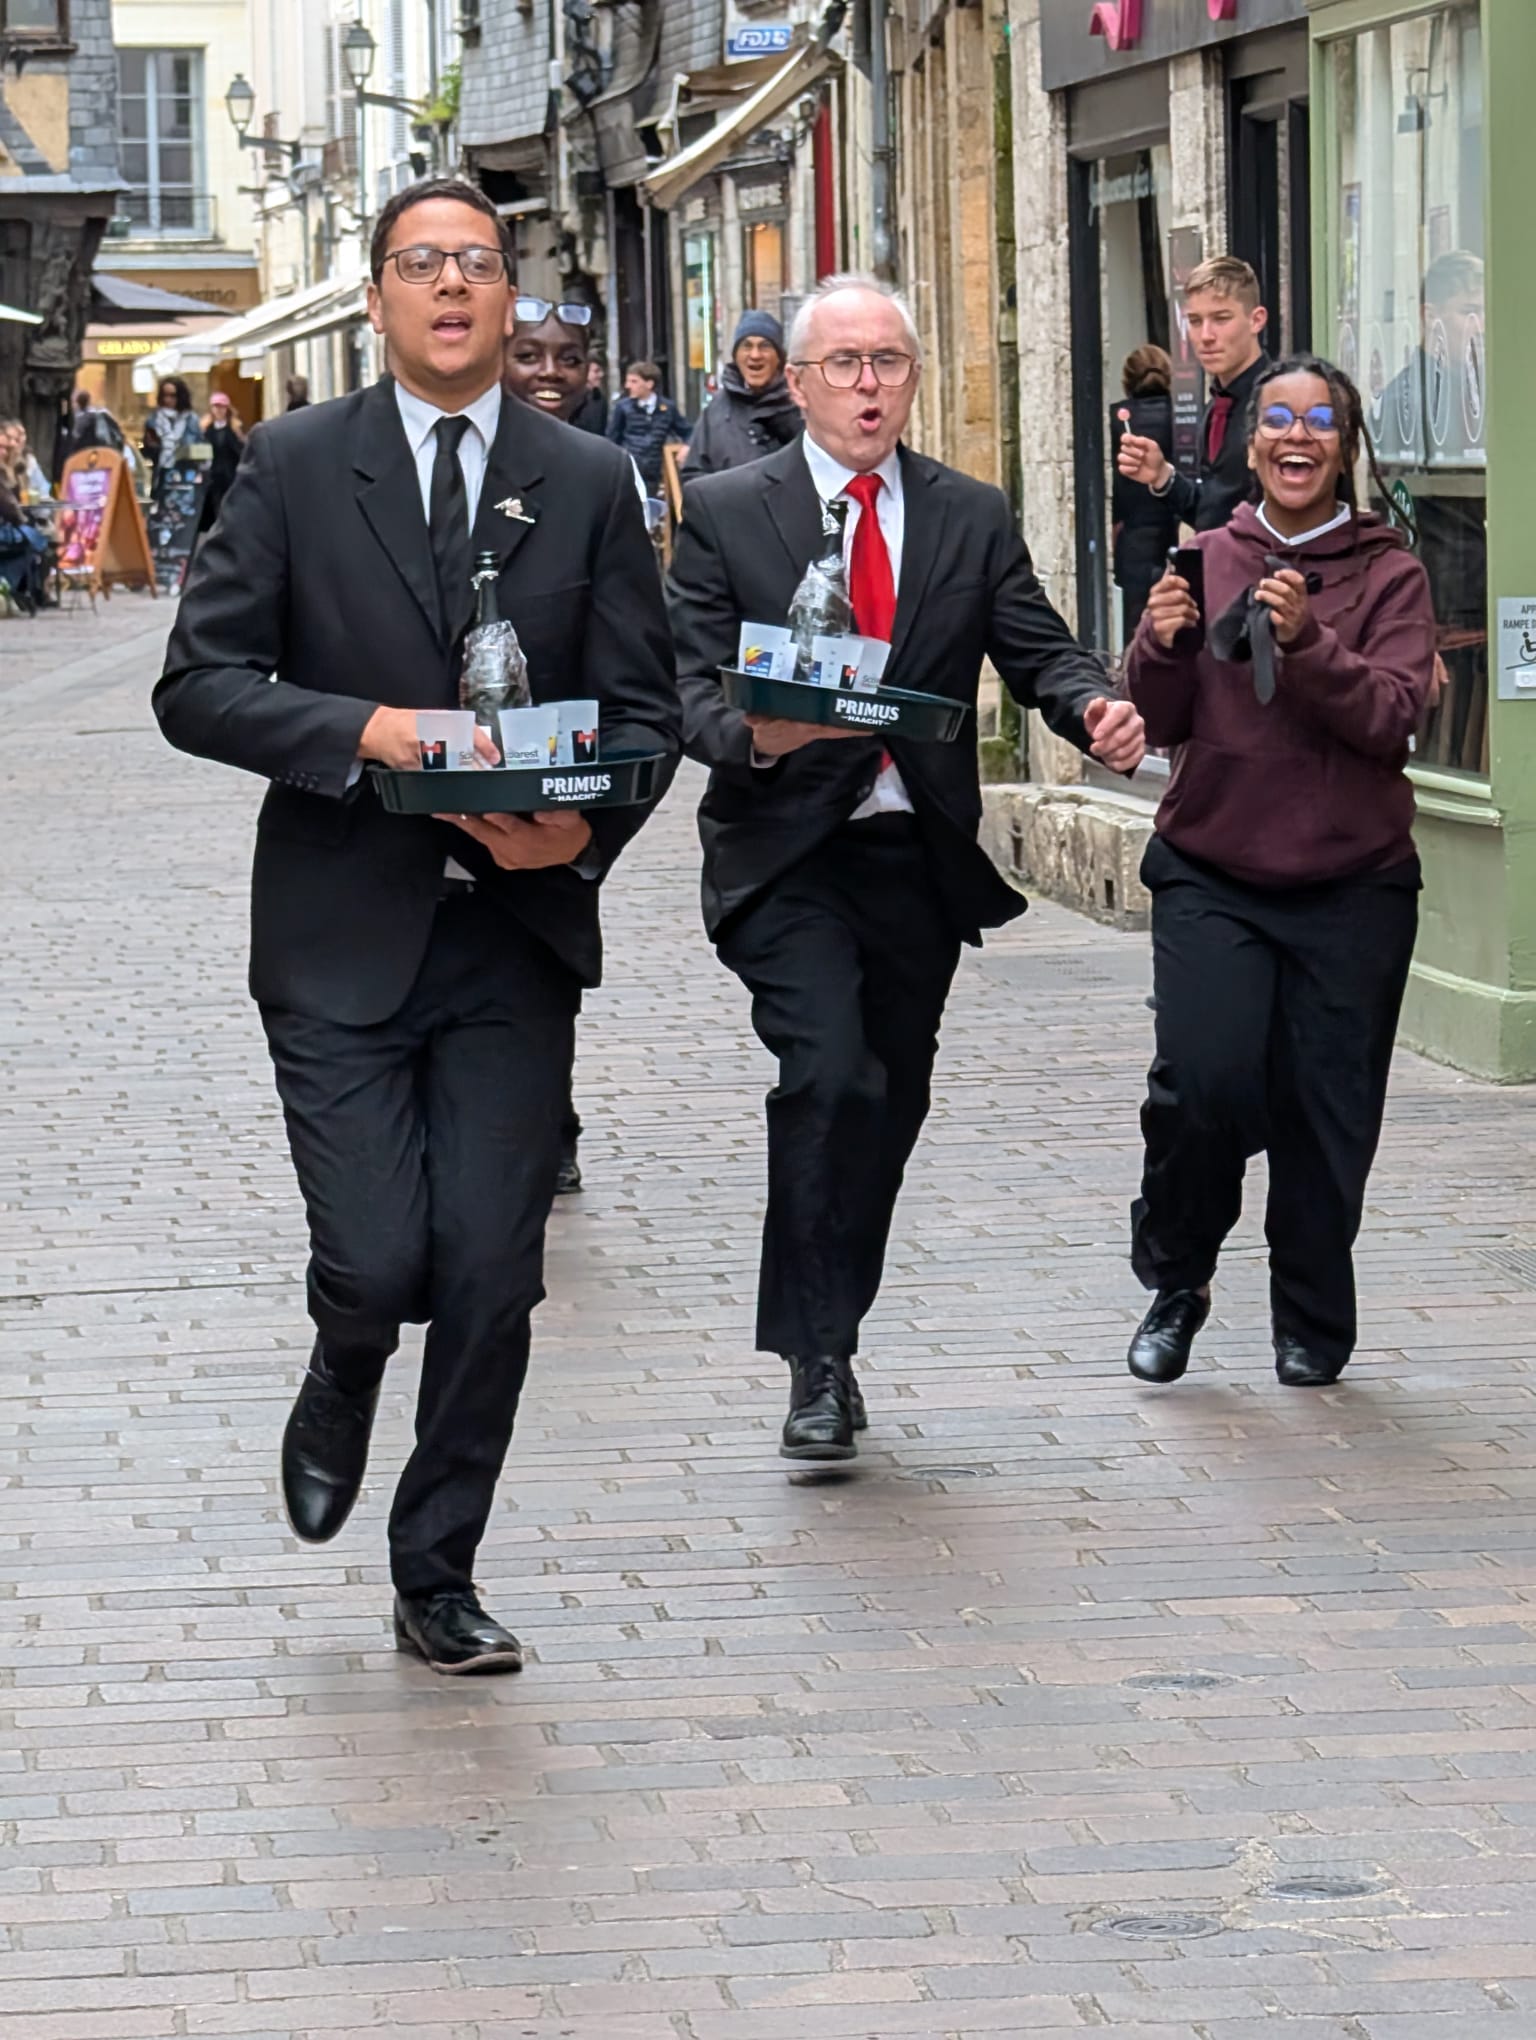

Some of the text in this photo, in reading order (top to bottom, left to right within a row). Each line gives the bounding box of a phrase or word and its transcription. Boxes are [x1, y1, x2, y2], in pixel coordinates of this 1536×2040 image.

[740, 31, 771, 46] FDJ
[1503, 619, 1530, 630] RAMPE
[834, 697, 900, 721] PRIMUS
[541, 774, 612, 795] PRIMUS
